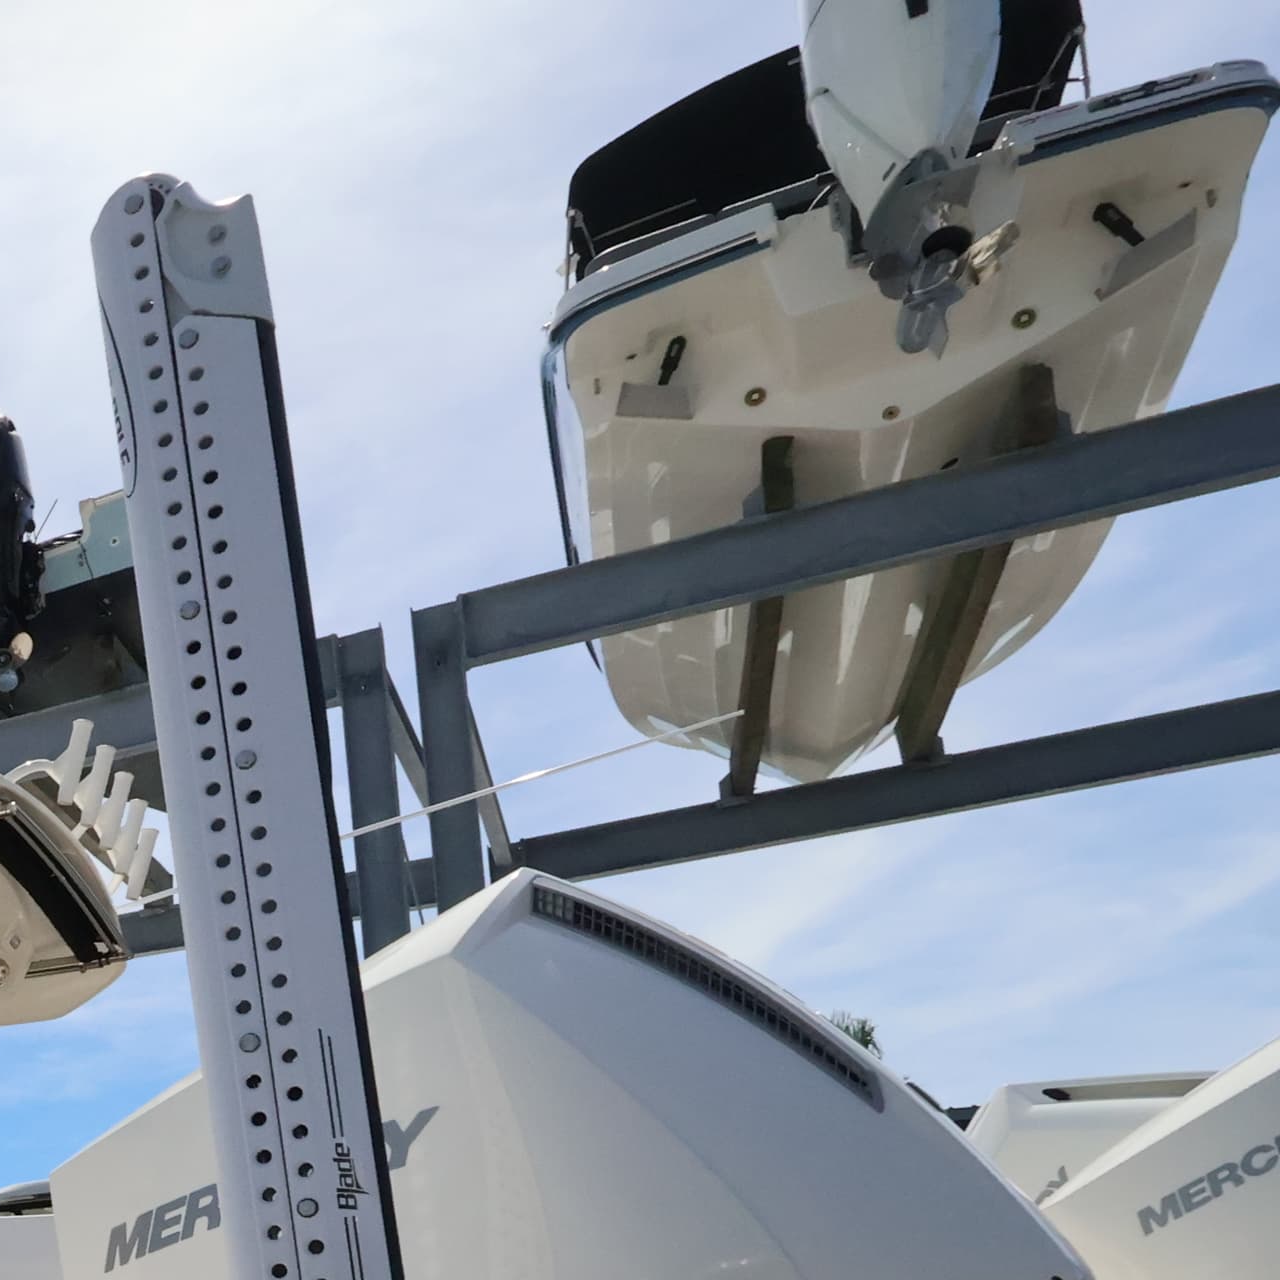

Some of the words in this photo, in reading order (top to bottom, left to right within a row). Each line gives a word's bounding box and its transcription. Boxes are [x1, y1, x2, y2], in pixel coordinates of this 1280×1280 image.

[104, 1105, 440, 1274] MERY
[332, 1142, 365, 1210] Blade
[1136, 1134, 1280, 1237] MERC
